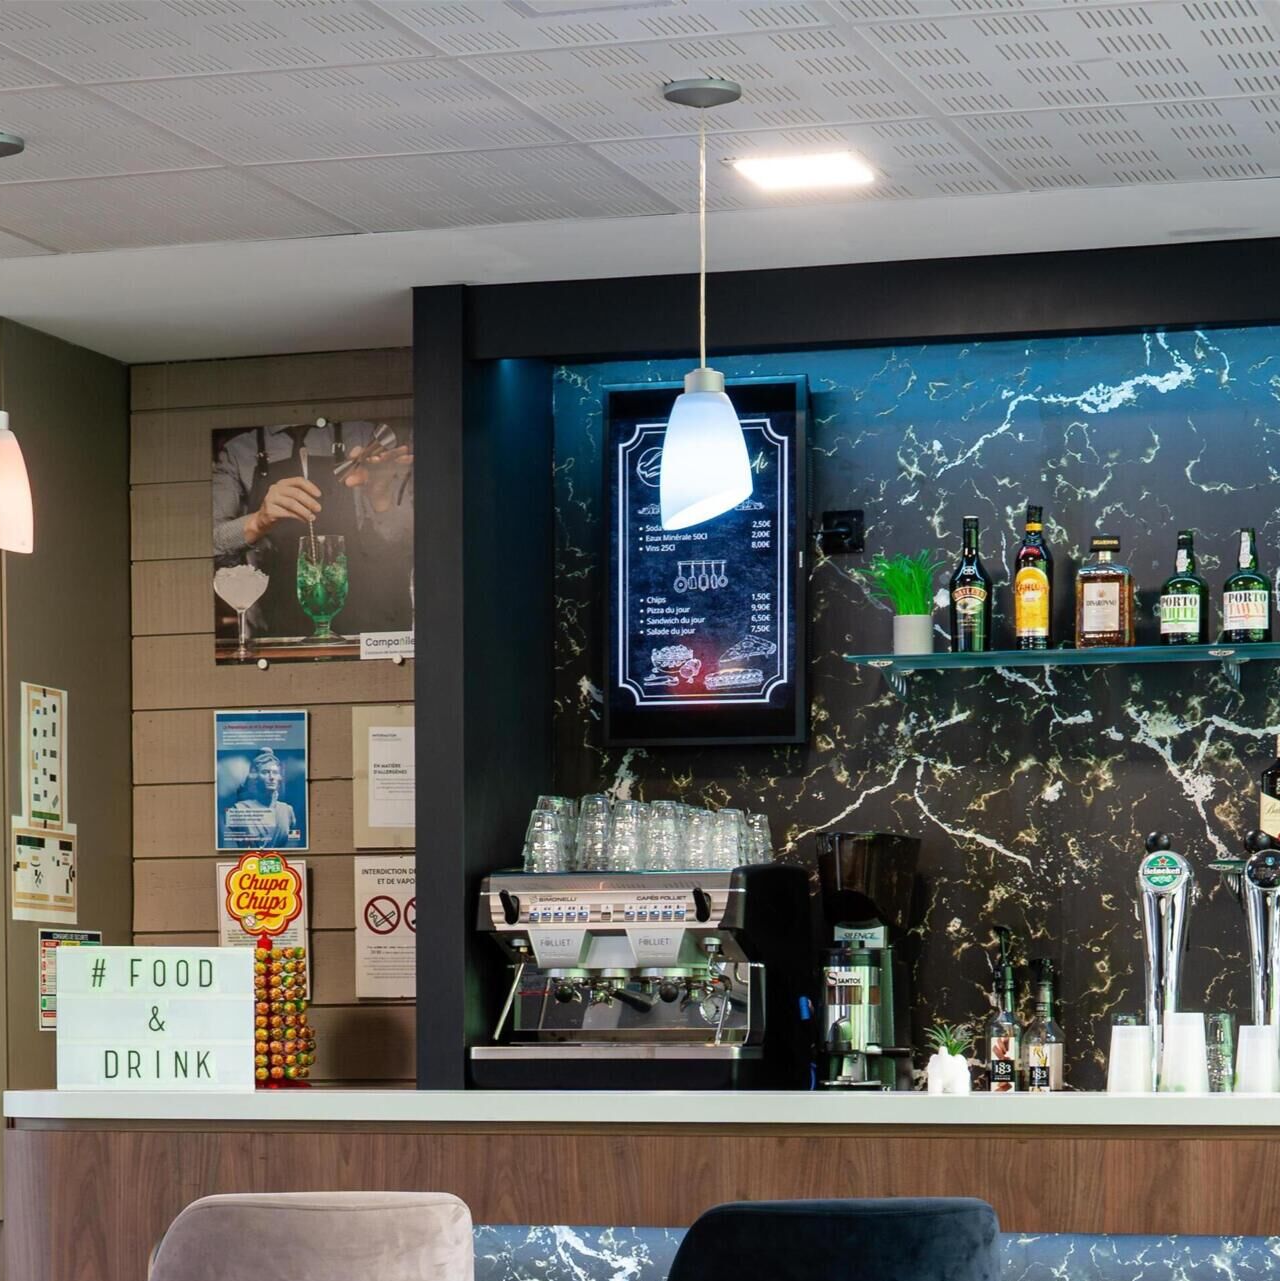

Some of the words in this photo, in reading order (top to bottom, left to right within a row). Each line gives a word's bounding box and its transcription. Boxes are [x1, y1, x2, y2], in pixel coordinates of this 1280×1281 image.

[752, 520, 771, 529] 2,50€
[751, 531, 770, 539] 2,00€
[751, 541, 770, 549] 8,00€
[751, 593, 771, 601] 1,50€
[1161, 596, 1198, 607] PORTO
[1228, 591, 1267, 603] PORTO
[751, 603, 771, 611] 9,90€
[751, 614, 771, 622] 6,50€
[751, 624, 770, 633] 7,50€
[361, 868, 408, 876] INTERDICTION
[1144, 867, 1181, 876] Heineken
[397, 877, 416, 885] VAPO
[238, 873, 290, 899] Chupa
[236, 891, 288, 915] Chups
[91, 958, 106, 988] #
[129, 958, 213, 988] FOOD
[148, 1005, 165, 1032] &
[104, 1050, 211, 1079] DRINK
